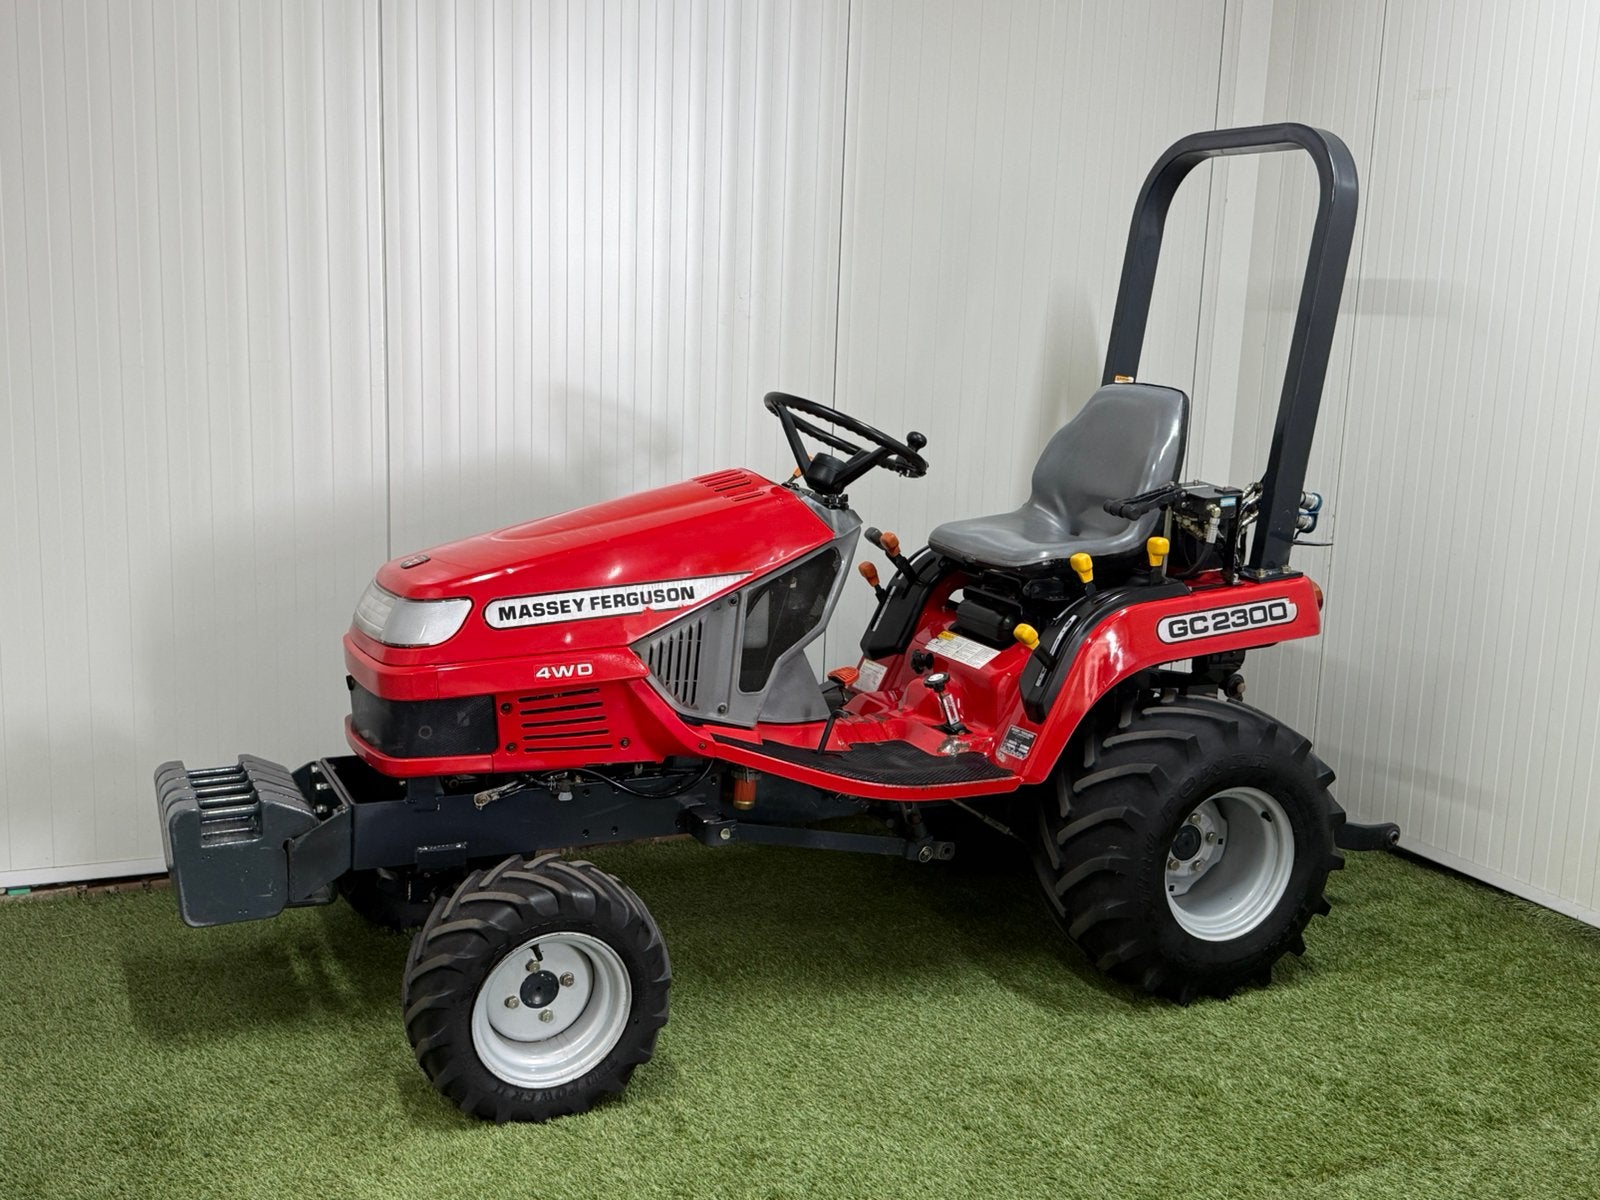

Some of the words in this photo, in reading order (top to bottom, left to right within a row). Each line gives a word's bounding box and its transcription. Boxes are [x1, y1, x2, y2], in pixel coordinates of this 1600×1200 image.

[498, 597, 585, 622] MASSEY
[590, 585, 696, 611] FERGUSON
[535, 663, 594, 680] 4WD
